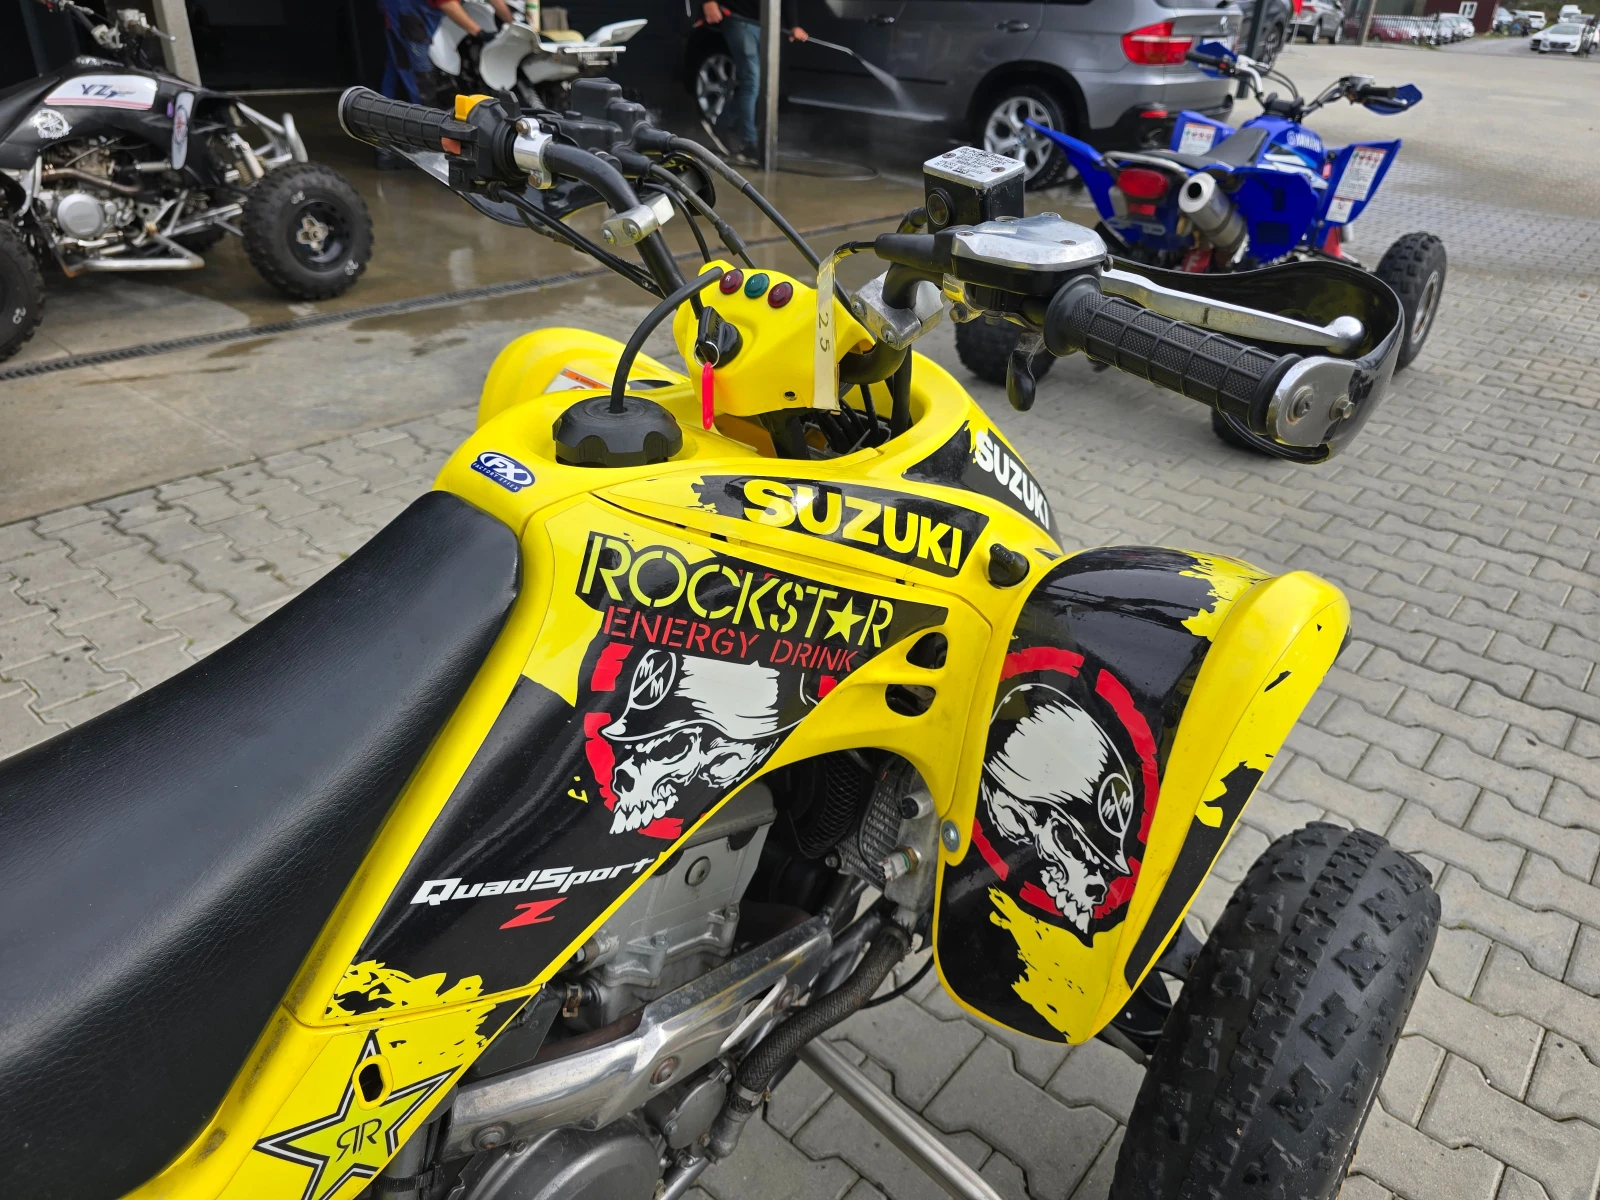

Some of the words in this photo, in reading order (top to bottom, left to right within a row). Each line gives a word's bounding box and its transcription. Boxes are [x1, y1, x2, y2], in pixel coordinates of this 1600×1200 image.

[472, 462, 498, 478] FACTORY
[498, 477, 519, 491] EFFEX
[974, 430, 1050, 530] SUZUKI
[742, 479, 964, 570] SUZUKI
[602, 605, 761, 659] ENERGY
[769, 638, 859, 673] DRINK
[410, 857, 656, 906] QuadSport
[499, 896, 568, 931] Z
